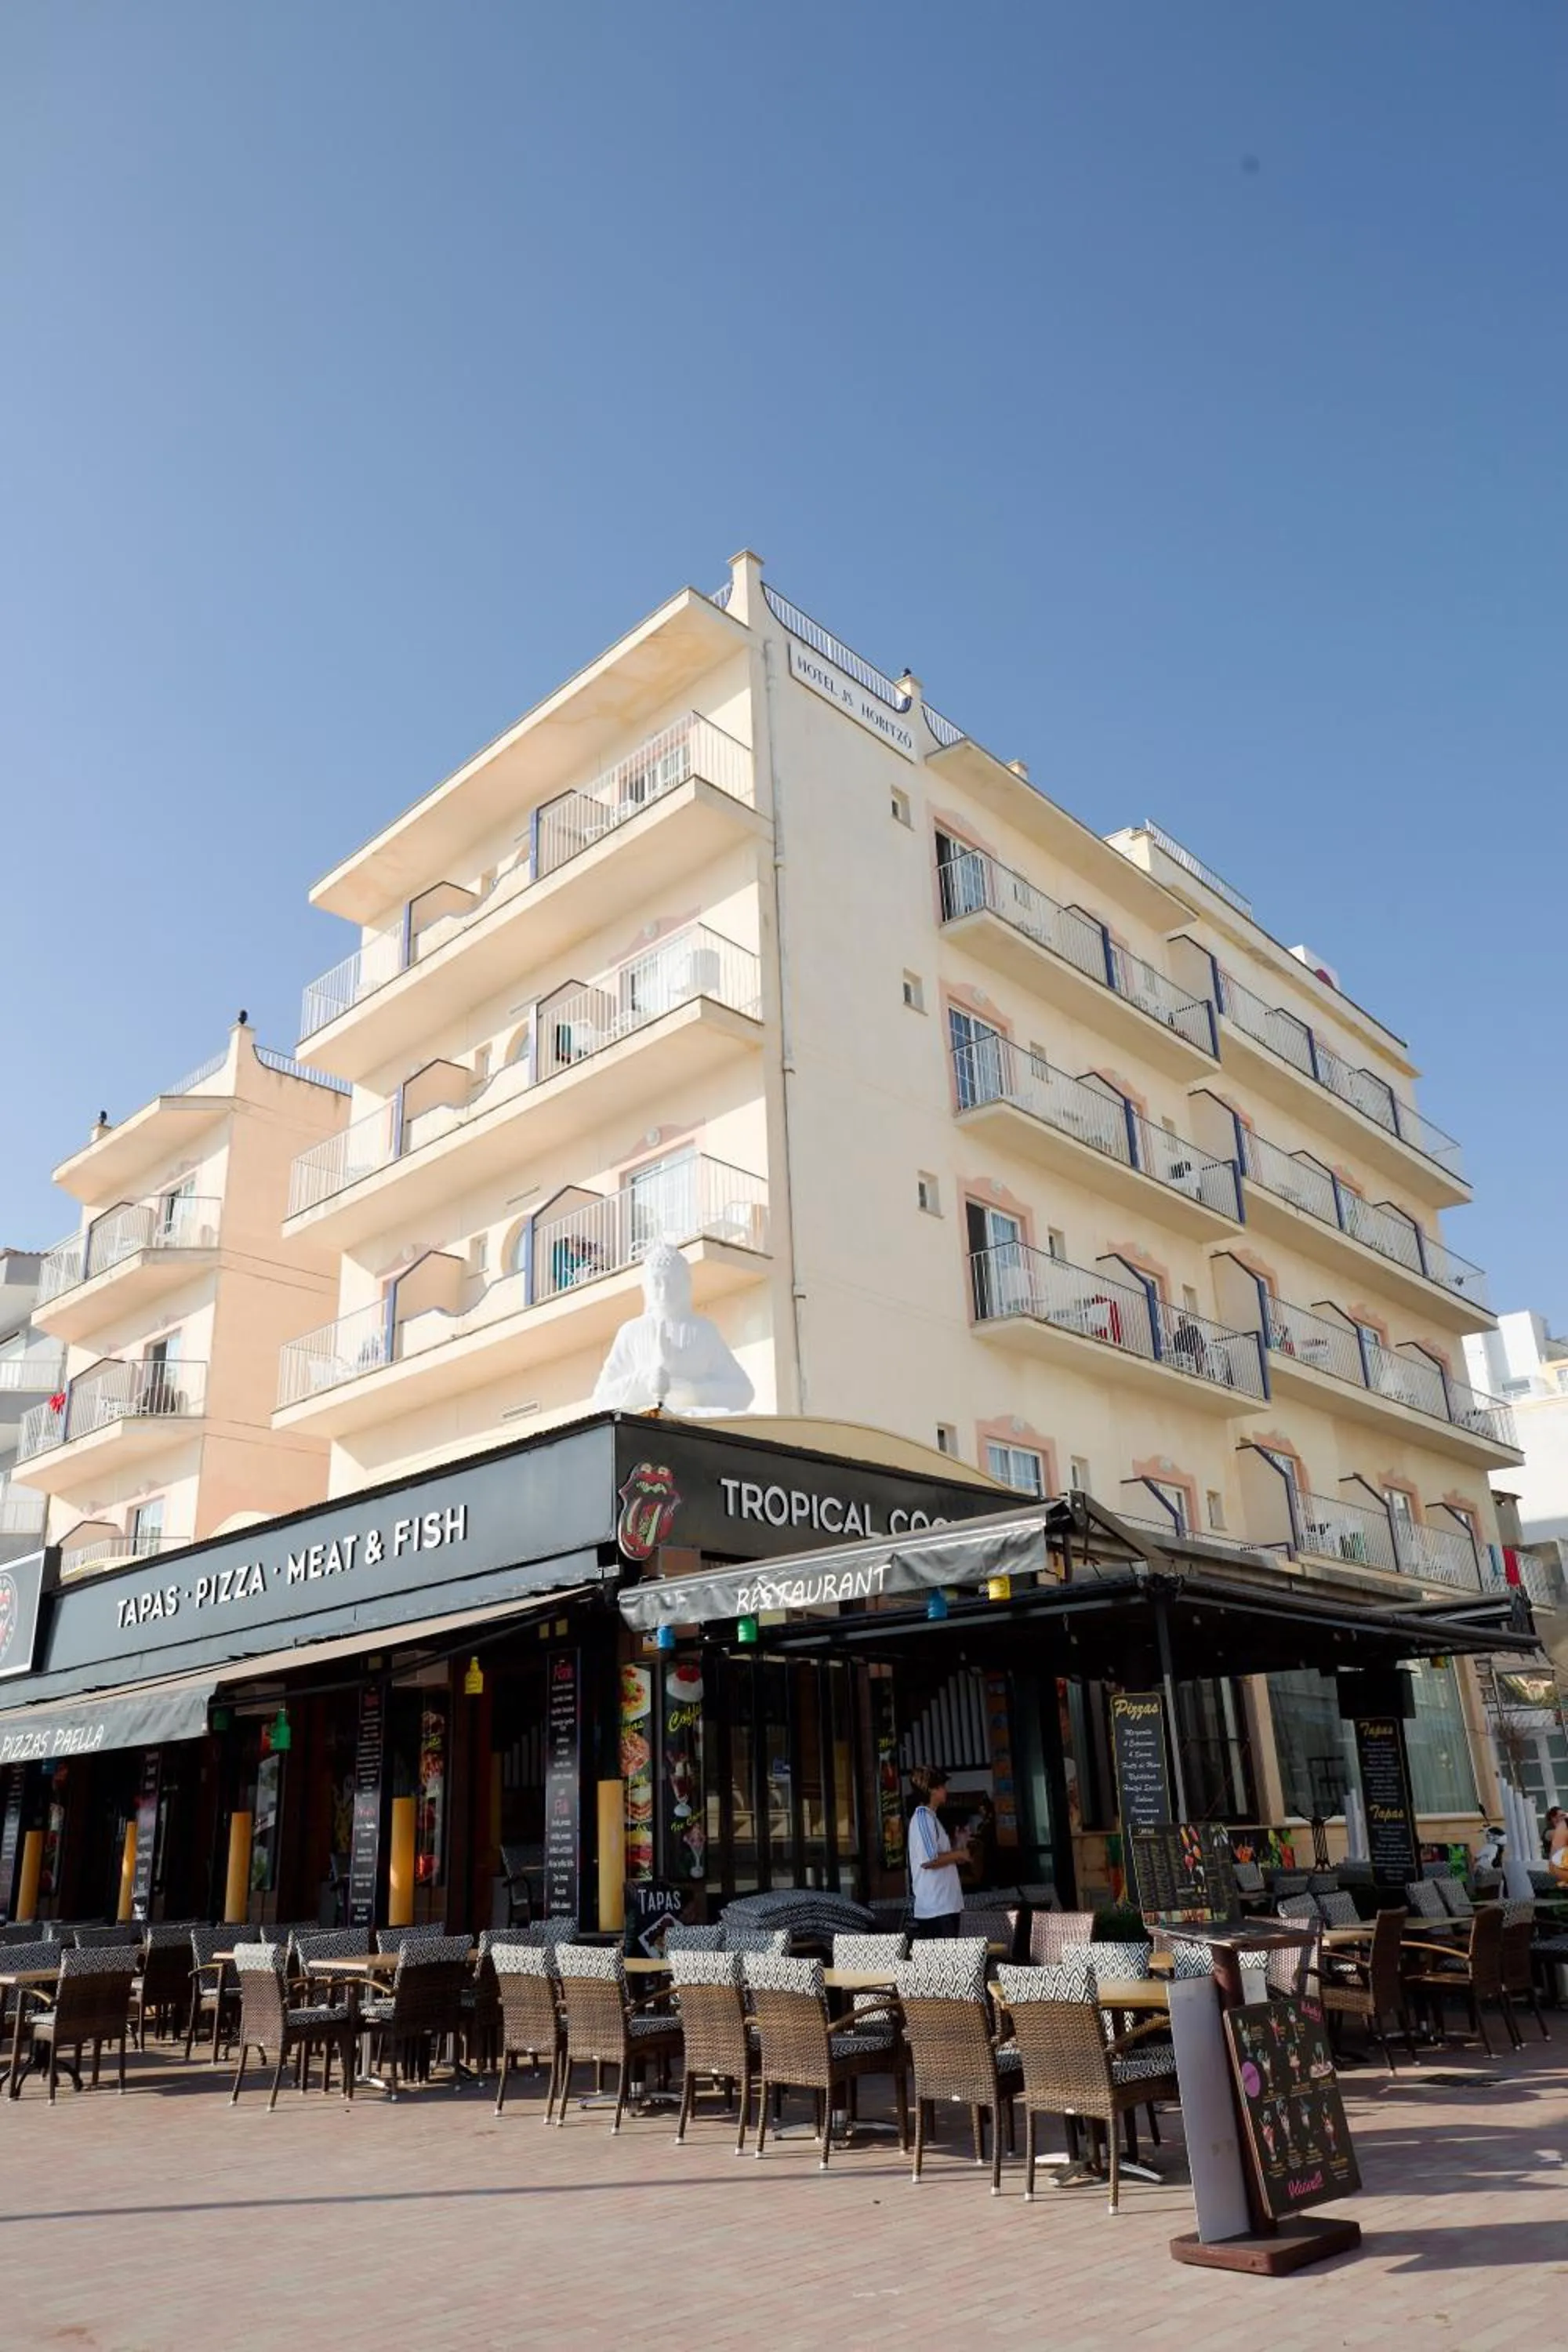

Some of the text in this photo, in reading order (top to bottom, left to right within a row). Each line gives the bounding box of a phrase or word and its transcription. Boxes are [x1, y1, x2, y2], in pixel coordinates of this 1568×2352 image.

[797, 655, 838, 696] HOTEL
[720, 1478, 954, 1539] TROPICAL CO
[117, 1504, 468, 1628] TAPAS PIZZA MEAT & FISH
[735, 1564, 891, 1613] RESTAURANT
[1114, 1699, 1159, 1721] Pizzas
[52, 1724, 104, 1756] PAELLA
[637, 1889, 681, 1915] TAPAS
